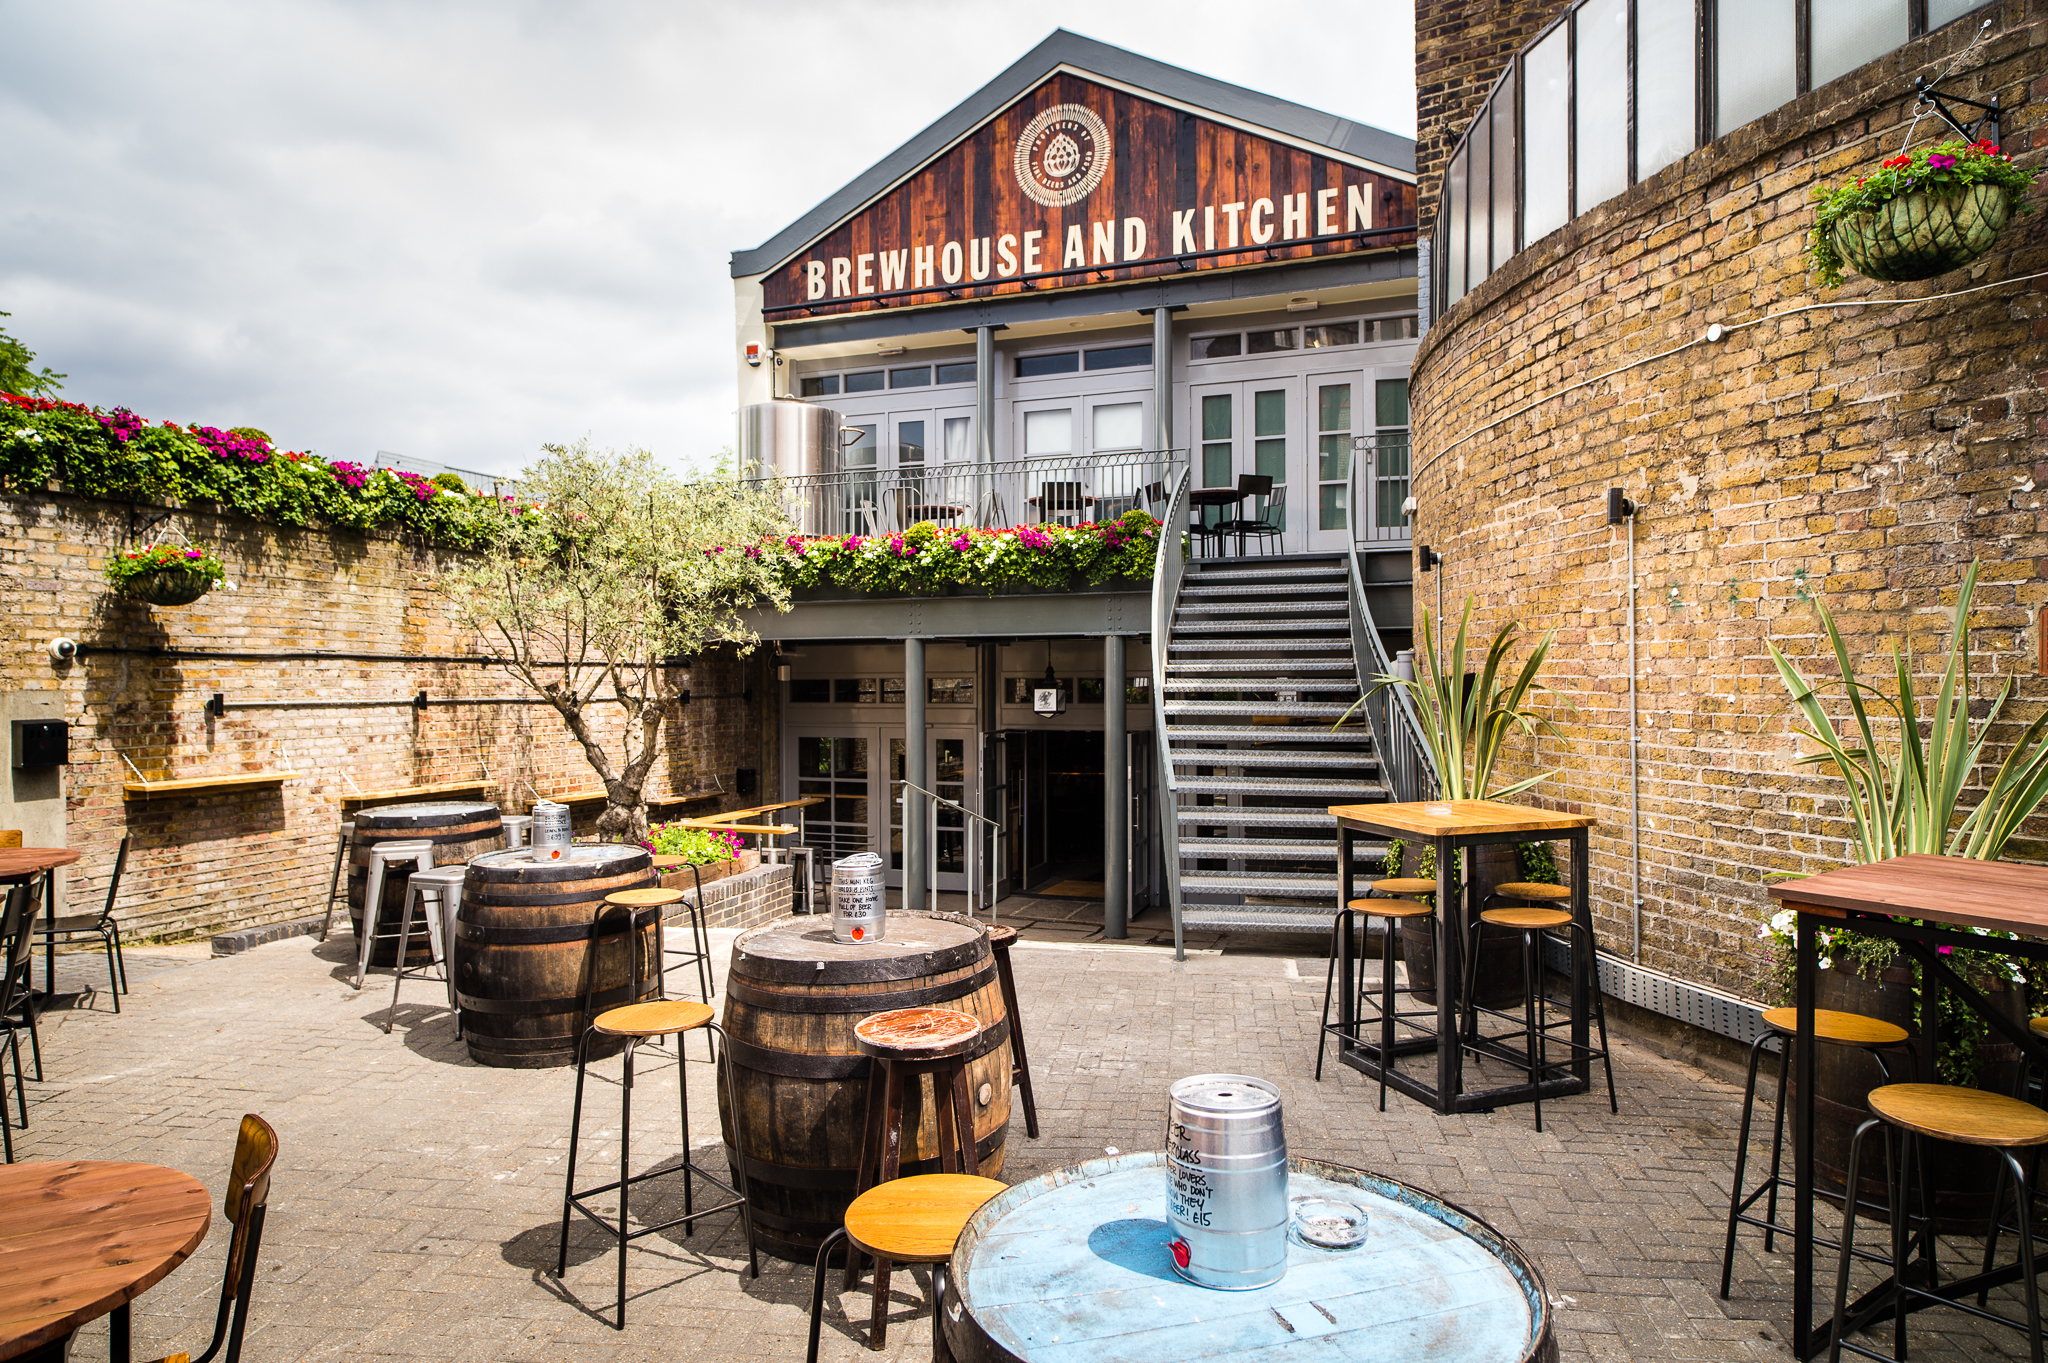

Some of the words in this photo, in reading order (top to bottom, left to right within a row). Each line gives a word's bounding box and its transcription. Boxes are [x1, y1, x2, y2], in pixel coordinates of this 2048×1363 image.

[1032, 122, 1078, 151] PROVIDERS
[1081, 130, 1091, 141] OF
[1031, 161, 1042, 179] FINE
[1042, 177, 1064, 188] BEERS
[1067, 173, 1081, 186] AND
[1081, 151, 1092, 171] FOOD
[807, 230, 1043, 300] BREWHOUSE
[1063, 217, 1147, 269] AND
[1172, 182, 1373, 256] KITCHEN
[843, 910, 854, 918] FOR
[858, 903, 872, 911] BEER
[1178, 1169, 1207, 1187] LOVERS
[1174, 1179, 1187, 1192] WHO
[1190, 1185, 1214, 1199] DON'T
[1180, 1193, 1205, 1211] THEY
